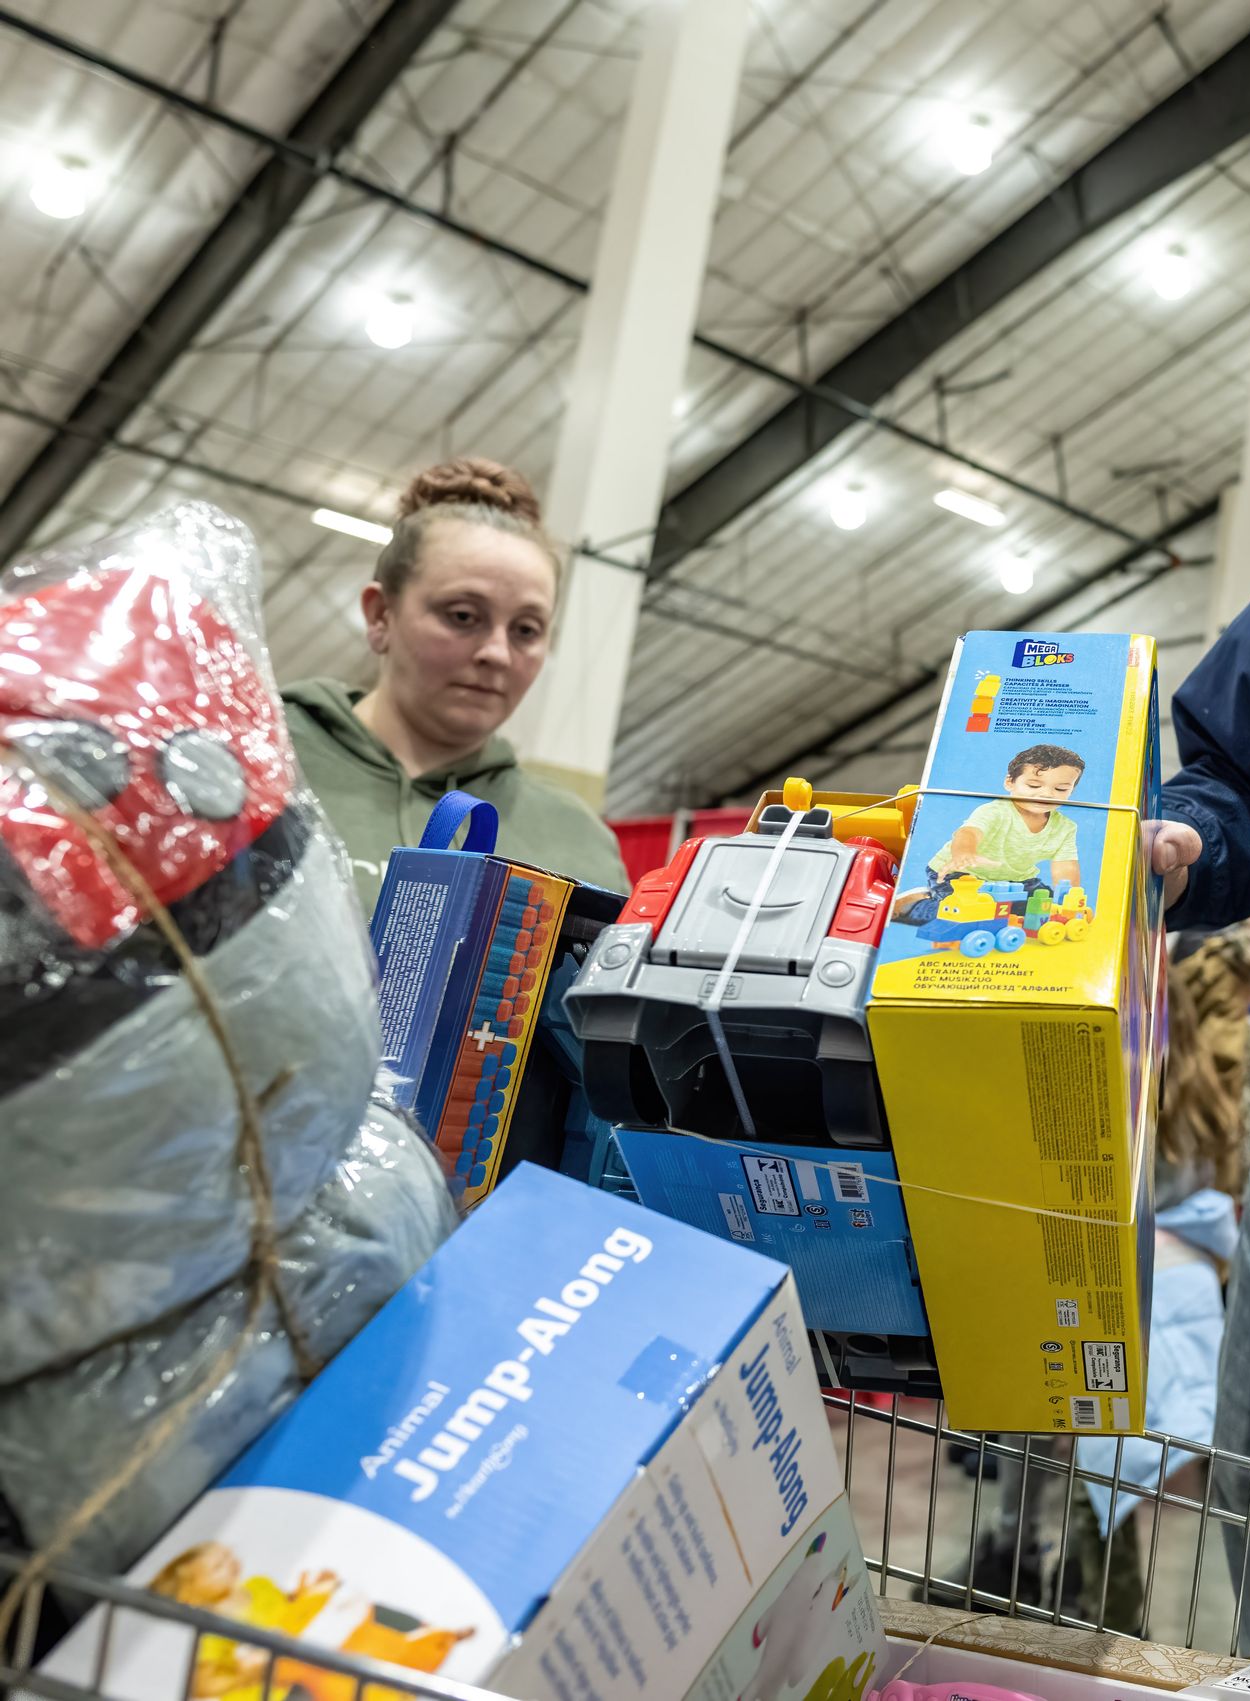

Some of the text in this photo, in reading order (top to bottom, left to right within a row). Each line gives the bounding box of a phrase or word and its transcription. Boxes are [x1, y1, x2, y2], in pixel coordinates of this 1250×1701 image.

[1022, 654, 1074, 668] BLOKS
[1027, 644, 1056, 653] MEGA
[982, 984, 1015, 992] ПОЕЗД
[393, 1226, 654, 1503] Jump-Along
[772, 1310, 801, 1377] Animal
[1111, 1344, 1121, 1373] Segurança
[360, 1380, 451, 1480] Animal
[738, 1343, 808, 1538] Jump-Along
